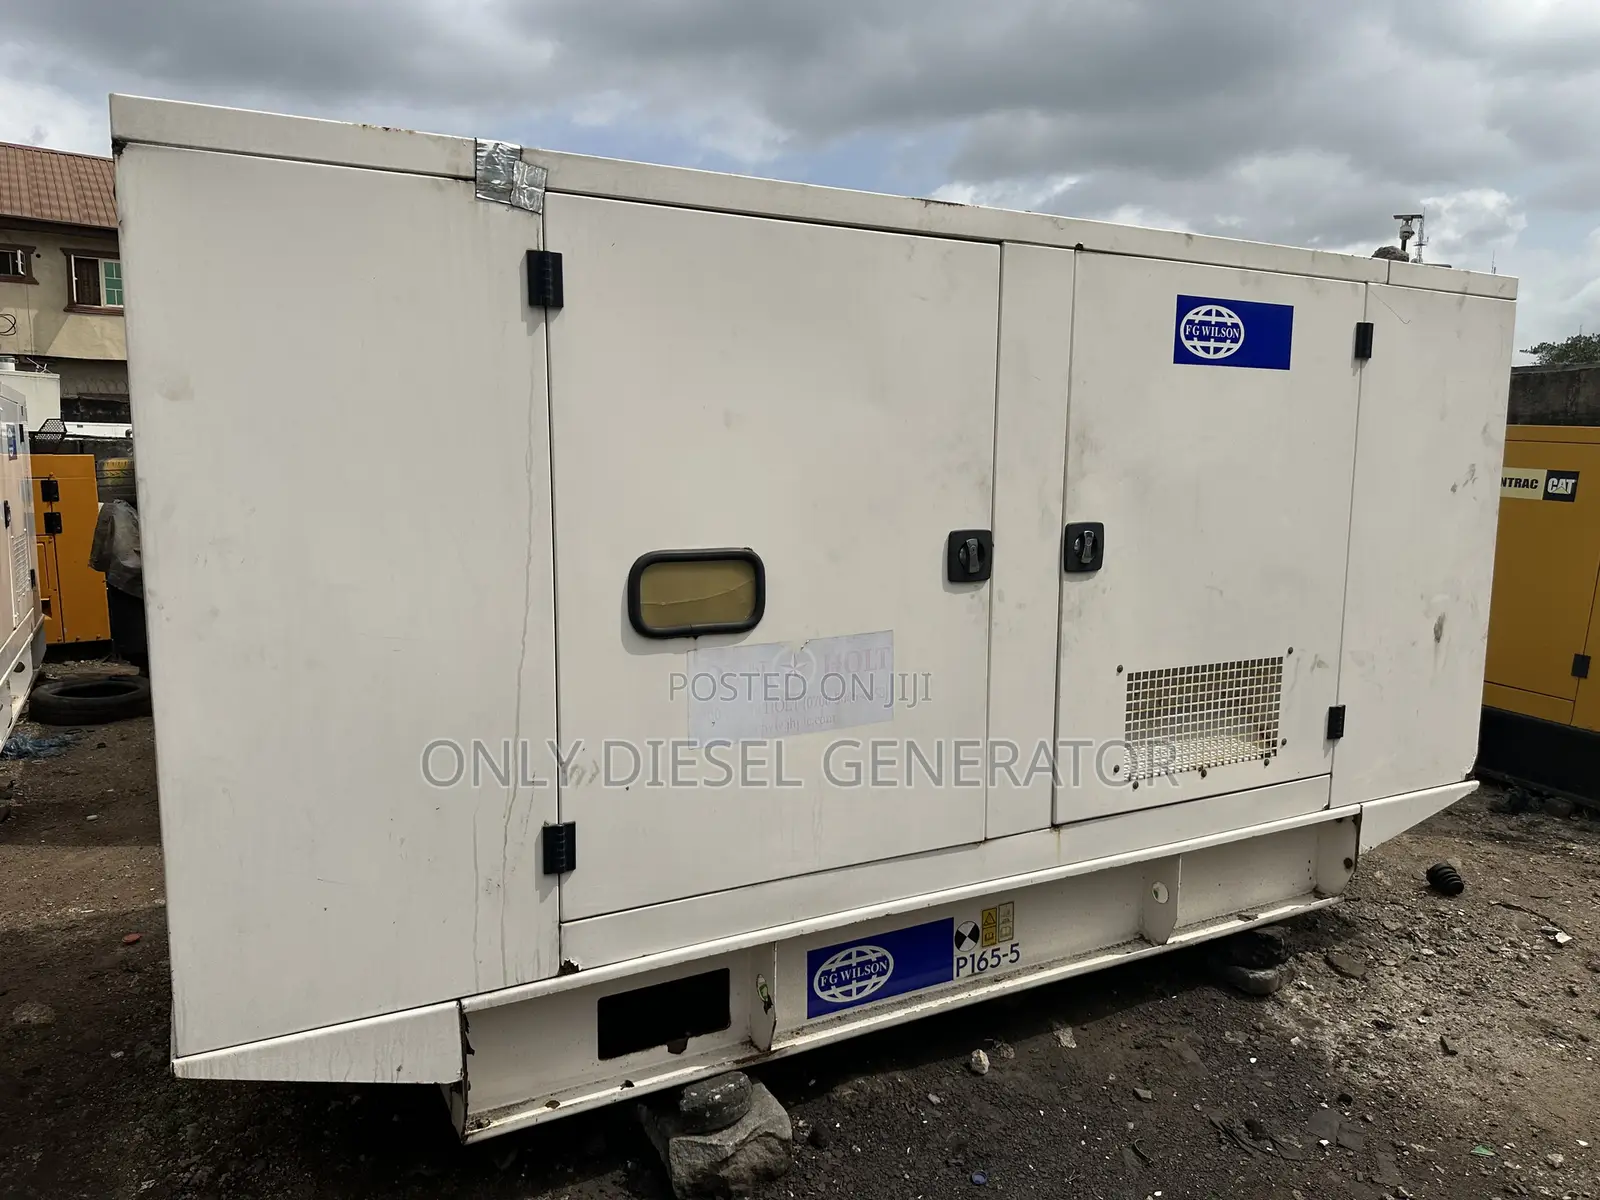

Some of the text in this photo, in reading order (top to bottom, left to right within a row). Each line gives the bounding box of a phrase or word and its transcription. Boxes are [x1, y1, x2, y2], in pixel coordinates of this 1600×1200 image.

[1185, 324, 1240, 339] FG WILSON
[1547, 477, 1576, 495] CAT
[955, 942, 1021, 978] P165-5
[820, 959, 889, 988] FG WILSON
